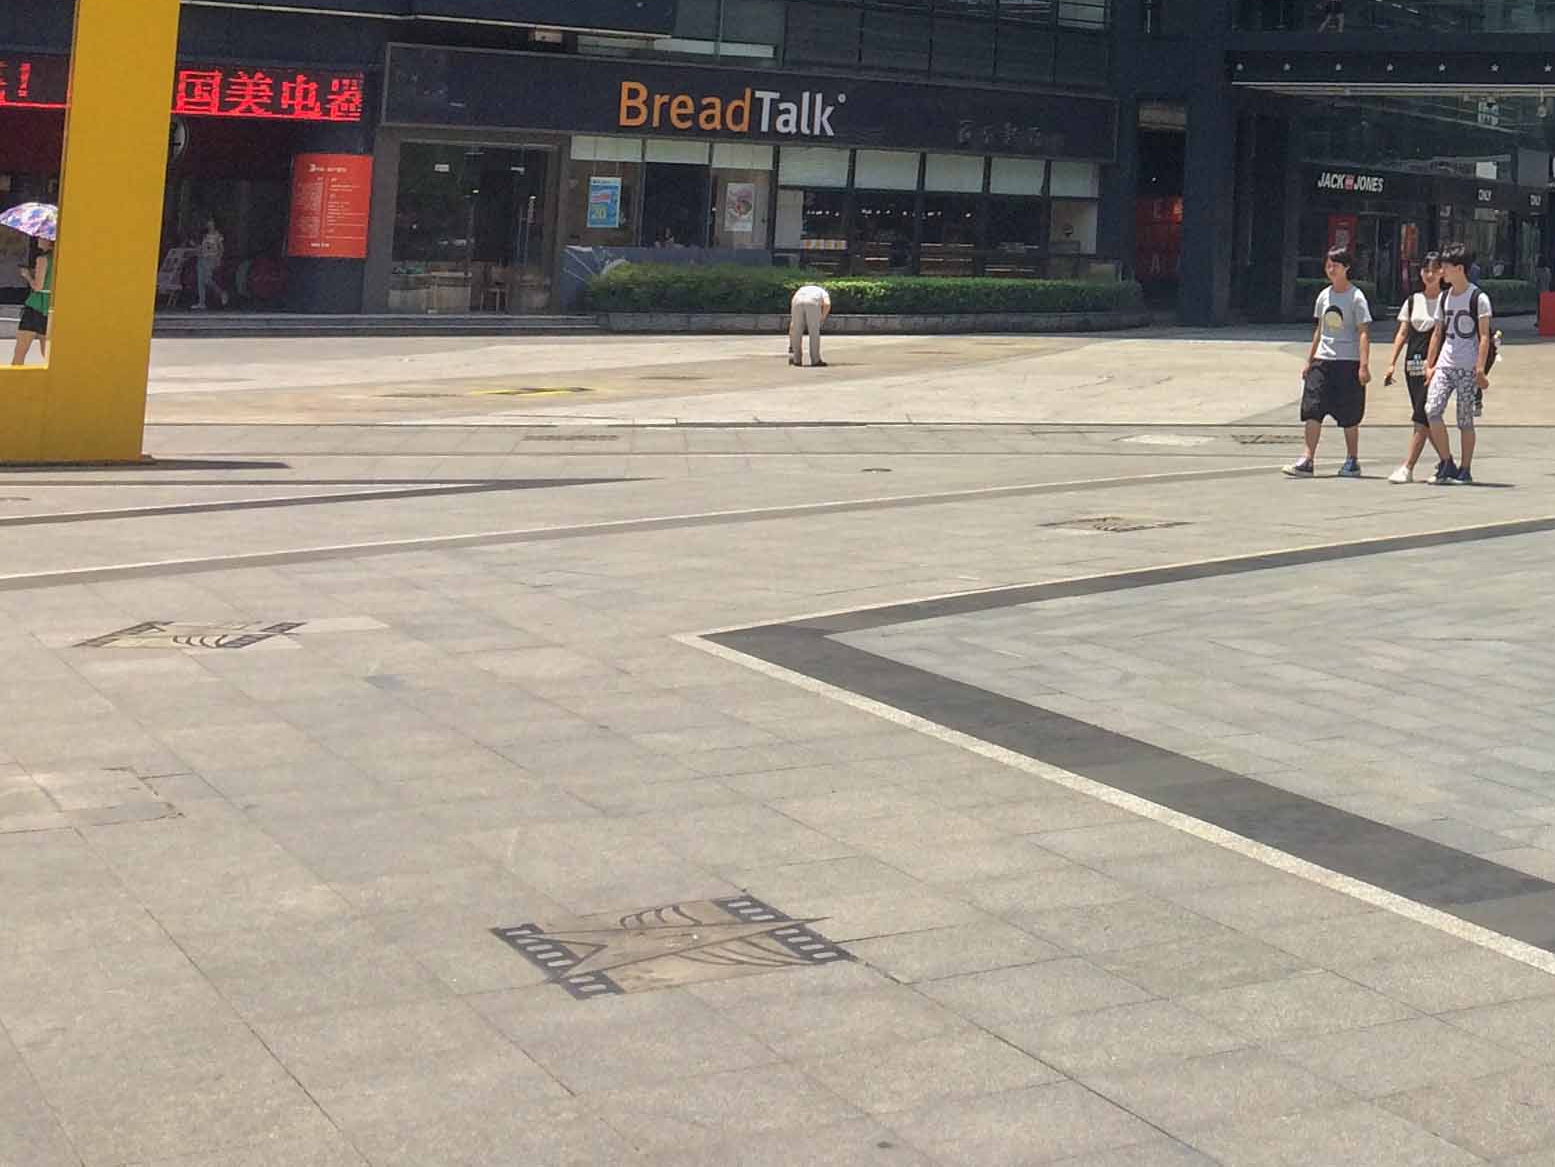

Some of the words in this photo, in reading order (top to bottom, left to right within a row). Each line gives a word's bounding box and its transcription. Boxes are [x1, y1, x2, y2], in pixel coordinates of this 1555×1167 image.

[176, 70, 363, 121] 国美电器
[618, 81, 836, 137] BreadTalk
